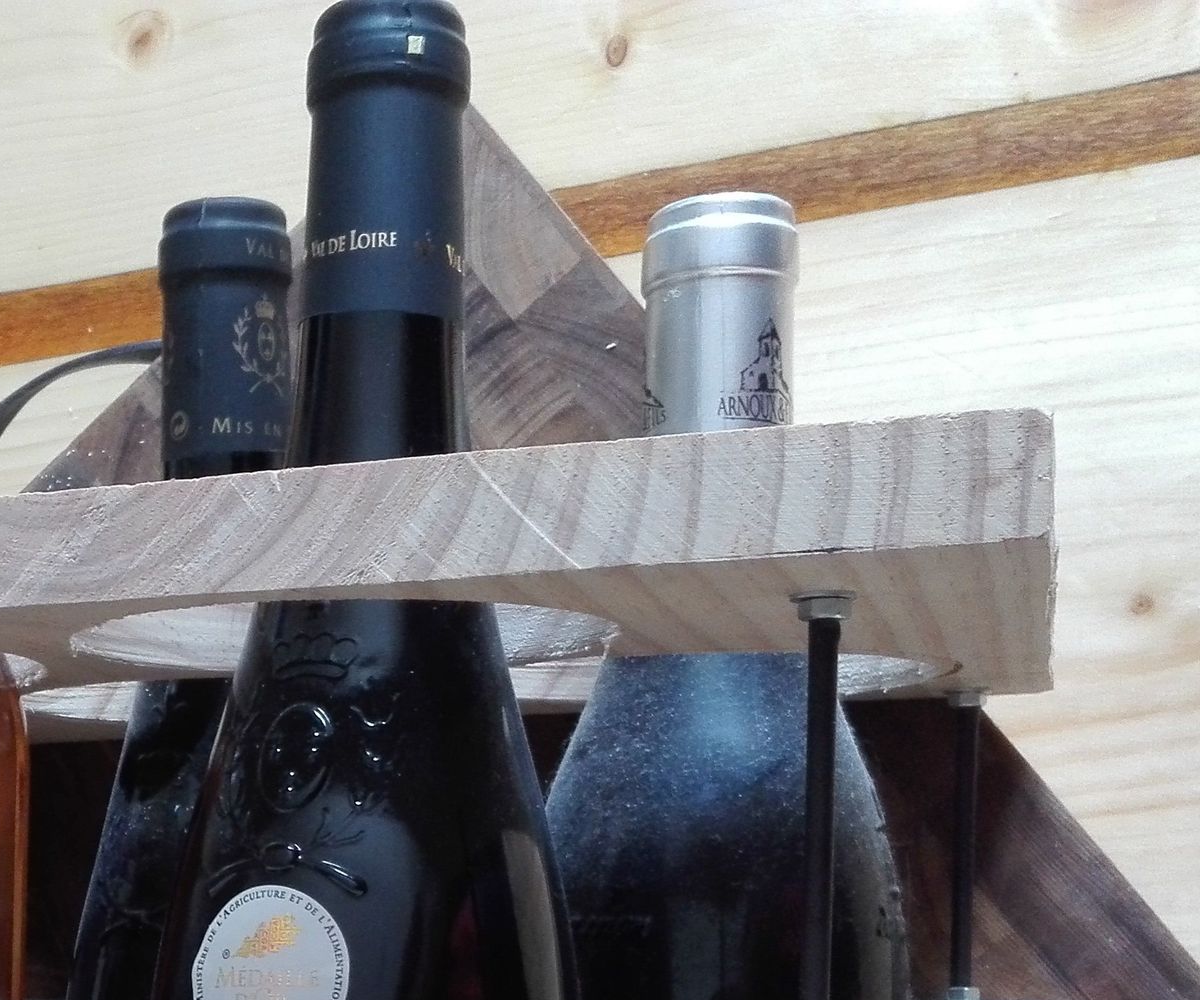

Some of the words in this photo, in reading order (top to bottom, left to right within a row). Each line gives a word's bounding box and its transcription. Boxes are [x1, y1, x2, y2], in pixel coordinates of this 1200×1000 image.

[327, 235, 346, 254] DE
[349, 229, 397, 251] LOIRE
[717, 393, 777, 421] ARNOUX
[211, 417, 254, 434] MIS
[208, 929, 218, 943] DE
[216, 889, 287, 927] L'AGRICULTURE
[289, 894, 304, 905] ET
[304, 902, 319, 917] DE
